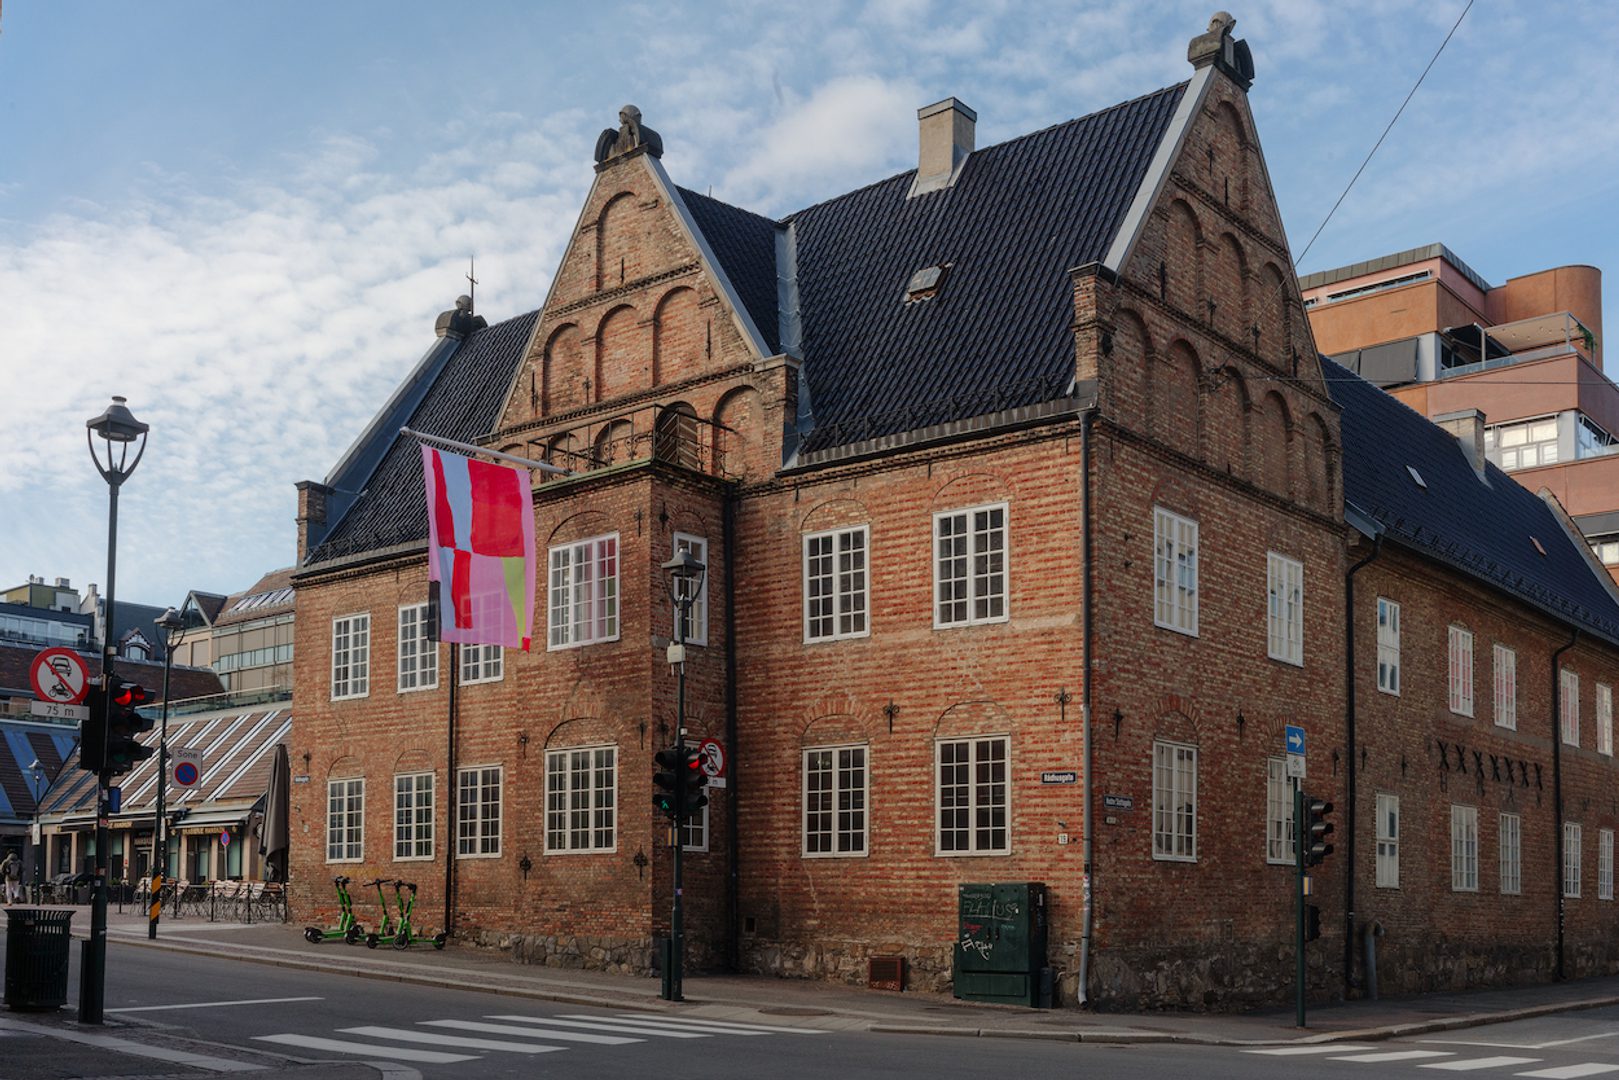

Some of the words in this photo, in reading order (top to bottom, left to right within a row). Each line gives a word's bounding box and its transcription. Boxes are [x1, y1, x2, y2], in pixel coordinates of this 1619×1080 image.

[46, 705, 59, 716] 75
[64, 708, 74, 717] m
[177, 750, 198, 759] Sone
